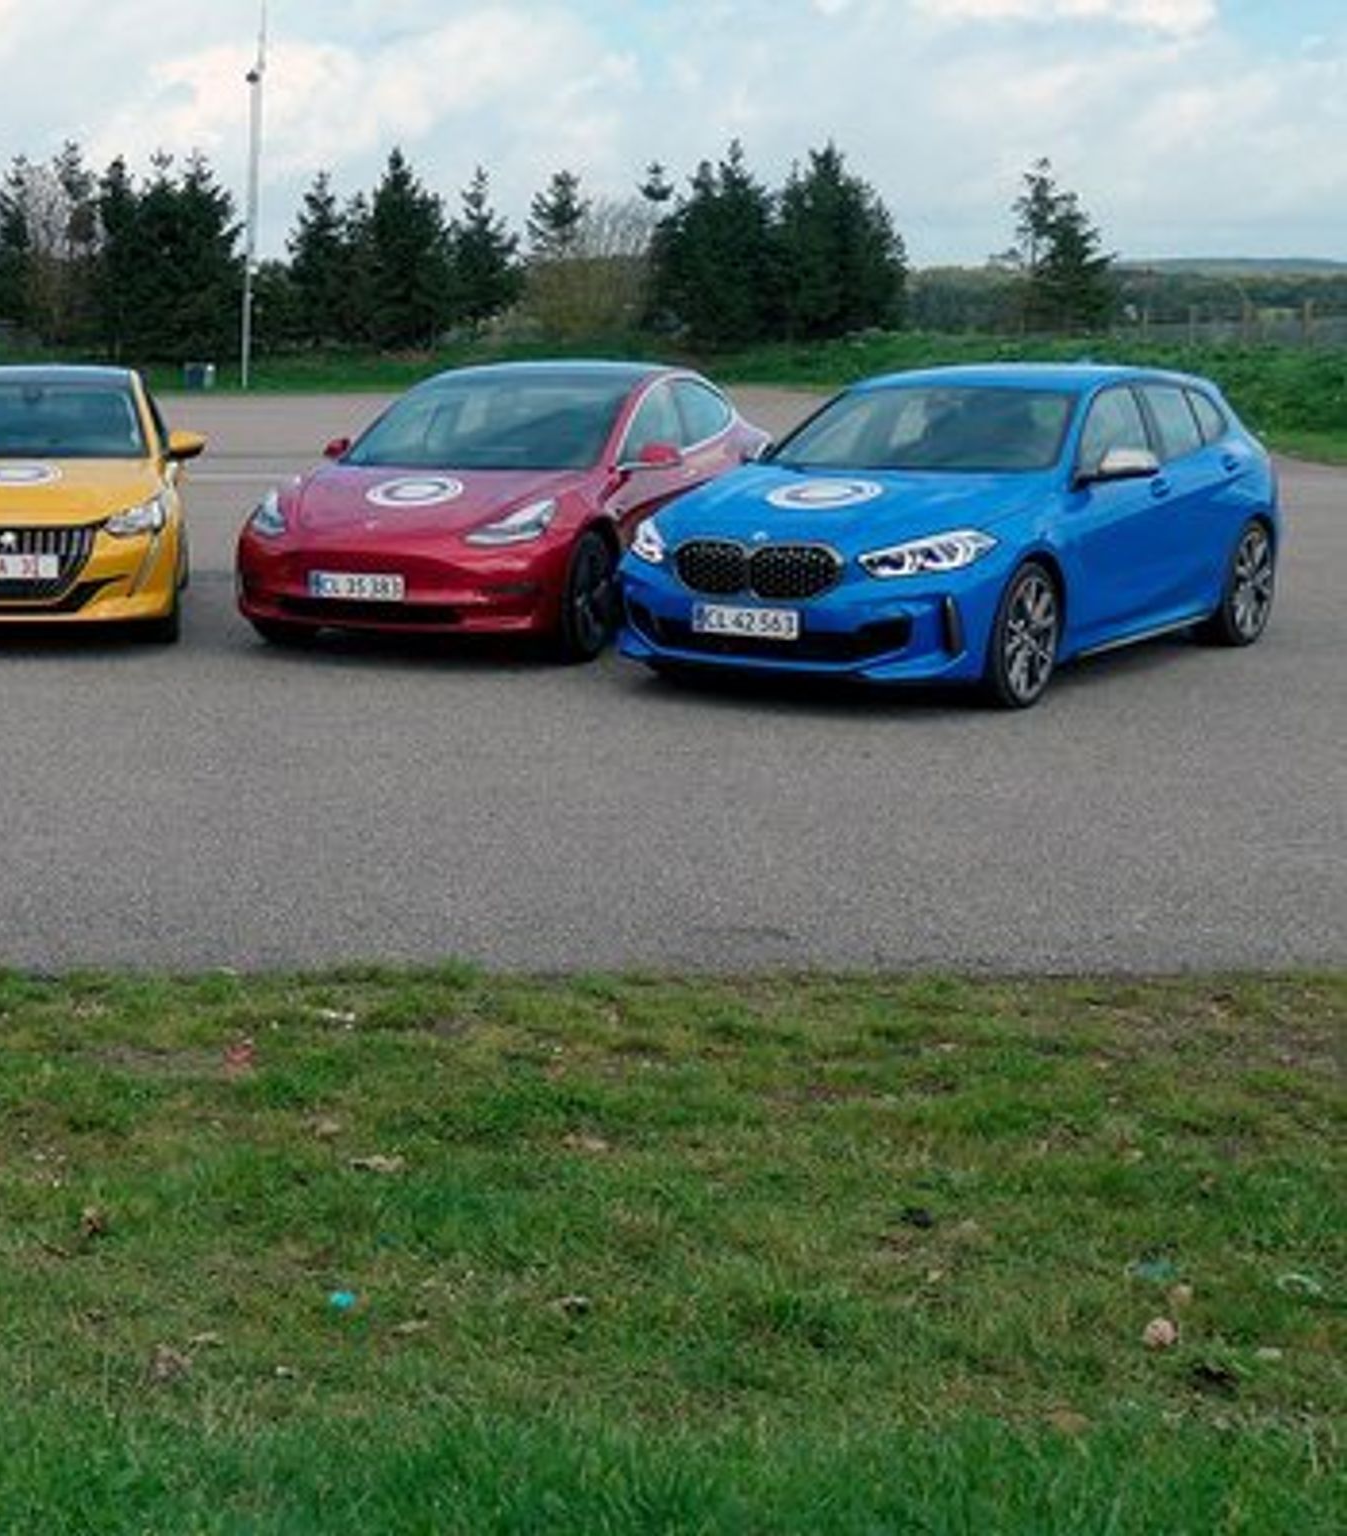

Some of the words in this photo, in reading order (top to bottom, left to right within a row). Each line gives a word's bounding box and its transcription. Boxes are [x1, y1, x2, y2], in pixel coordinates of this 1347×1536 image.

[321, 576, 341, 595] CL
[706, 608, 728, 630] CL
[732, 610, 756, 633] 42
